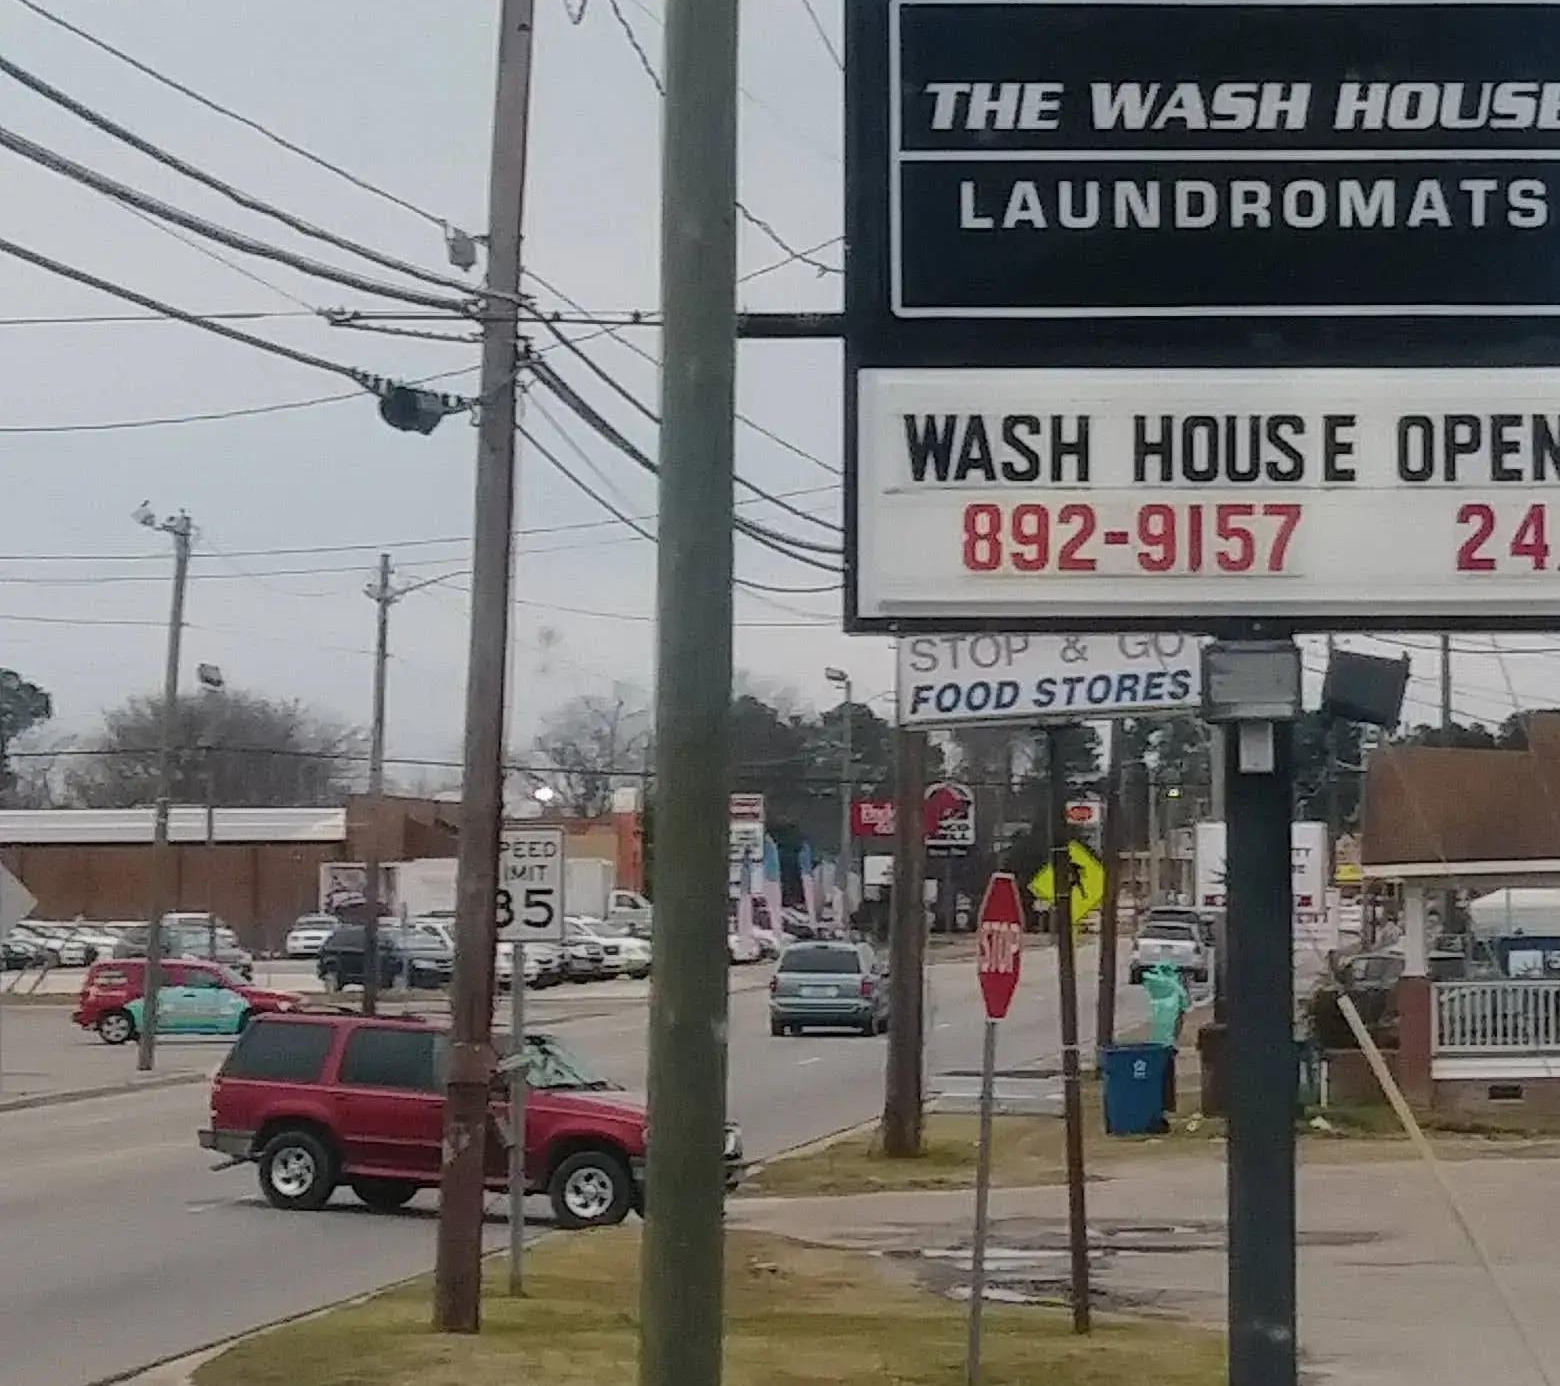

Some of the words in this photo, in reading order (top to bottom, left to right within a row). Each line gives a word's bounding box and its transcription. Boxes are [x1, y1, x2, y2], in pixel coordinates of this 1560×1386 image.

[925, 81, 1065, 131] THE
[1090, 81, 1312, 131] WASH
[959, 179, 1549, 229] LAUNDROMATS
[903, 413, 1092, 483] WASH
[1133, 414, 1357, 483] HOUSE
[961, 502, 1303, 573] 892-9157
[909, 634, 1030, 673] STOP
[1060, 634, 1089, 664] &
[910, 679, 1021, 715] FOOD
[1032, 668, 1193, 708] STORES
[499, 841, 557, 858] PEED
[504, 864, 549, 882] IMIT
[495, 889, 554, 929] 35
[979, 921, 1019, 974] STOP
